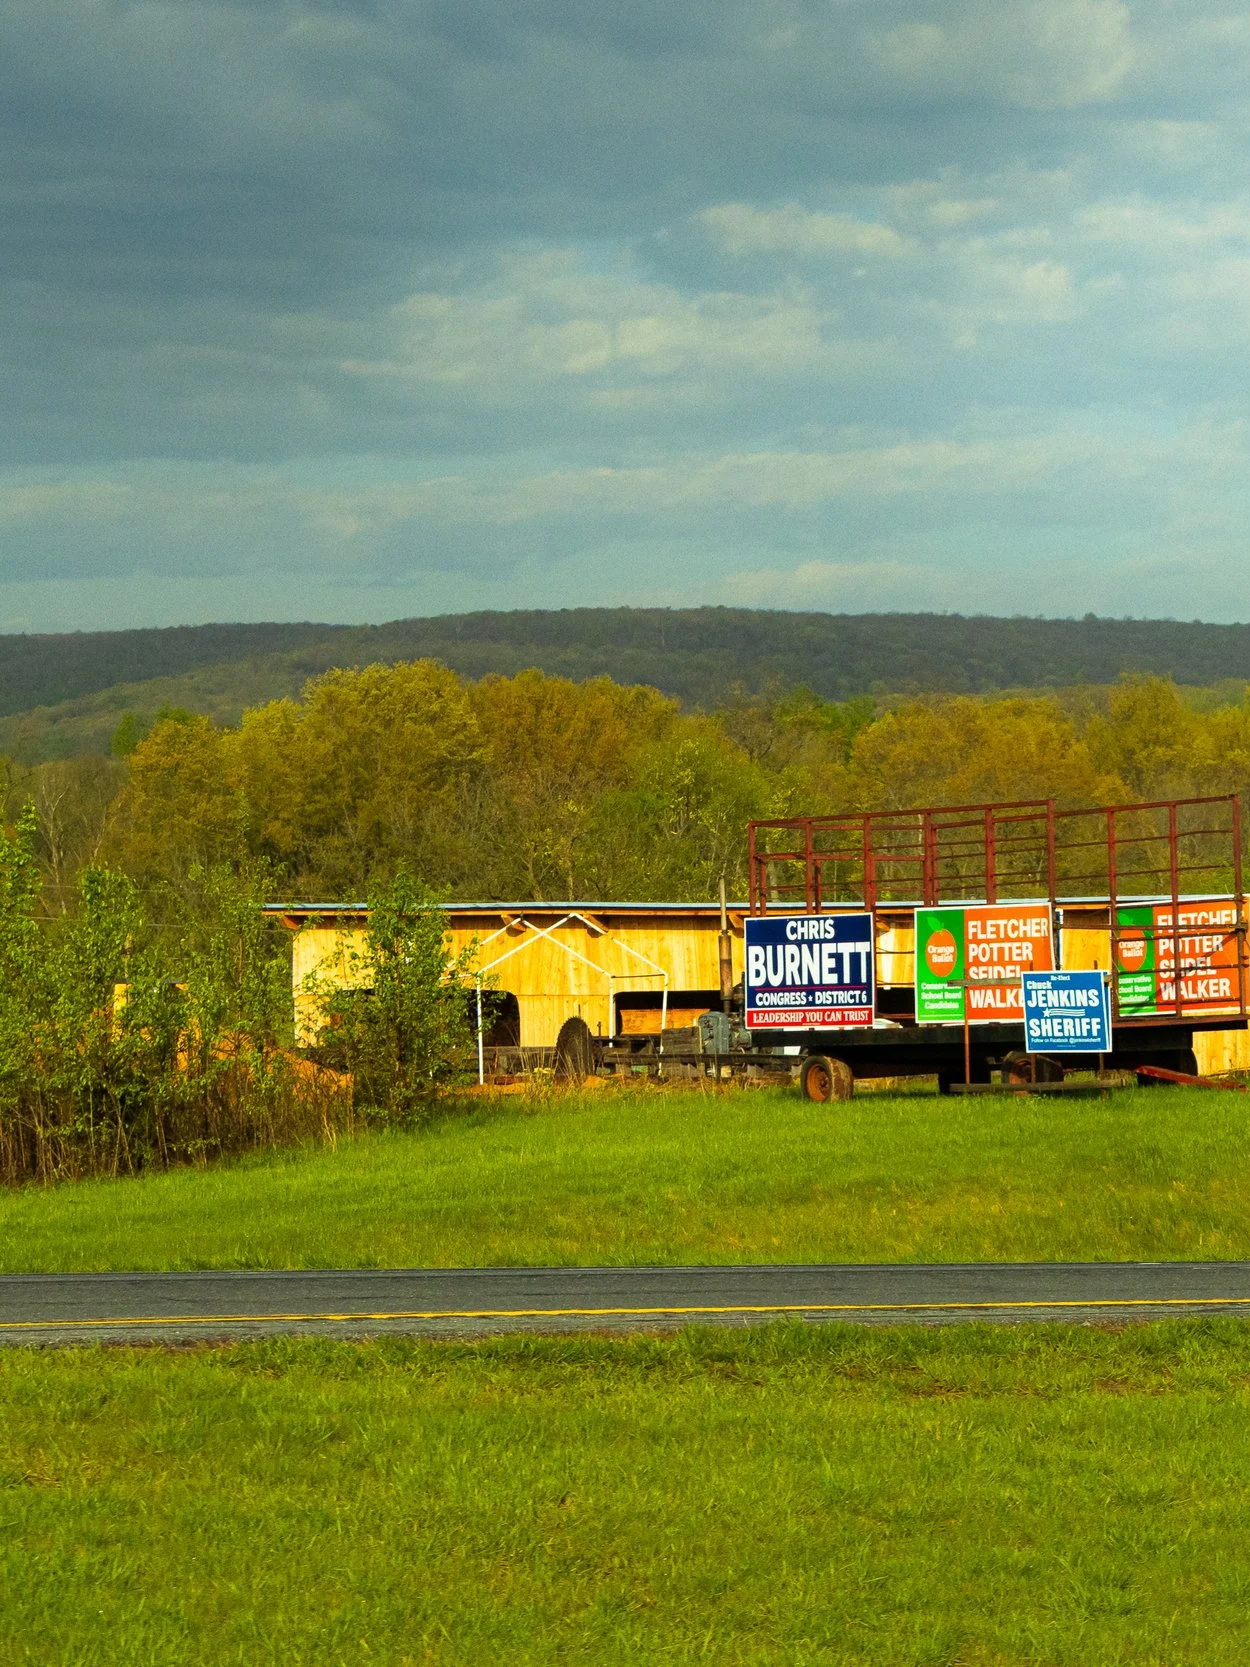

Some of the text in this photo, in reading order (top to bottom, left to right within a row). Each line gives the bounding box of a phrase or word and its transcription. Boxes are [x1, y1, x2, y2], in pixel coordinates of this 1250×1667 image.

[786, 919, 835, 940] CHRIS
[968, 918, 1048, 940] FLETCHER
[927, 945, 955, 954] Orange
[968, 942, 1033, 962] POTTER
[1122, 949, 1143, 957] Ballot
[748, 941, 870, 987] BURNETT
[932, 954, 954, 963] Ballot
[1026, 980, 1052, 990] Chuck
[1118, 985, 1134, 994] chool
[1160, 978, 1231, 1000] WALKER
[755, 990, 867, 1006] CONGRESS DISTRICT 6
[921, 991, 943, 1000] School
[1027, 989, 1100, 1008] JENKINS
[753, 1010, 869, 1024] LEADERSHIP YOU CAN TRUST
[1029, 1018, 1101, 1037] SHERIFF
